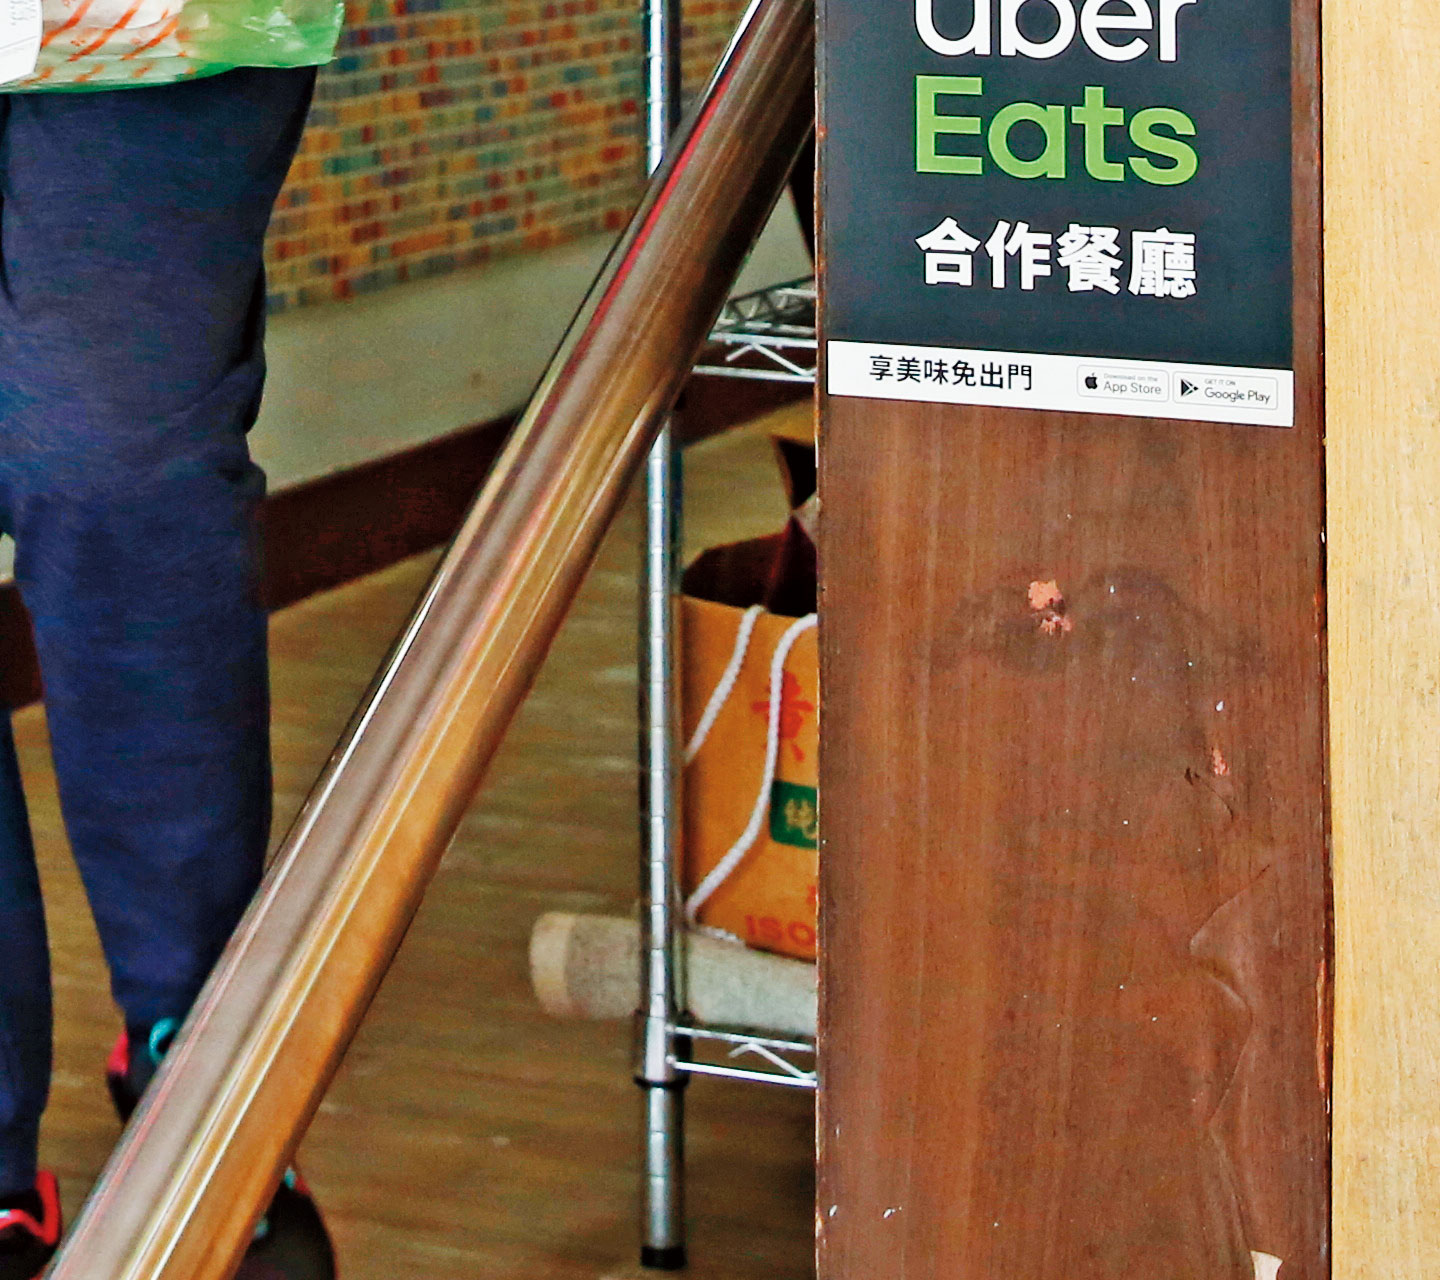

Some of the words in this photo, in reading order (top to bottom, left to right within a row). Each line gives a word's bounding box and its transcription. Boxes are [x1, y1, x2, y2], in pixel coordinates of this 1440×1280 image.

[914, 74, 1200, 186] Eats
[914, 218, 1198, 299] 合作餐廳
[868, 354, 1033, 392] 享美味免出門
[1103, 381, 1128, 393] App
[1130, 382, 1162, 394] Store
[1205, 387, 1245, 403] Google
[1247, 391, 1270, 405] Play
